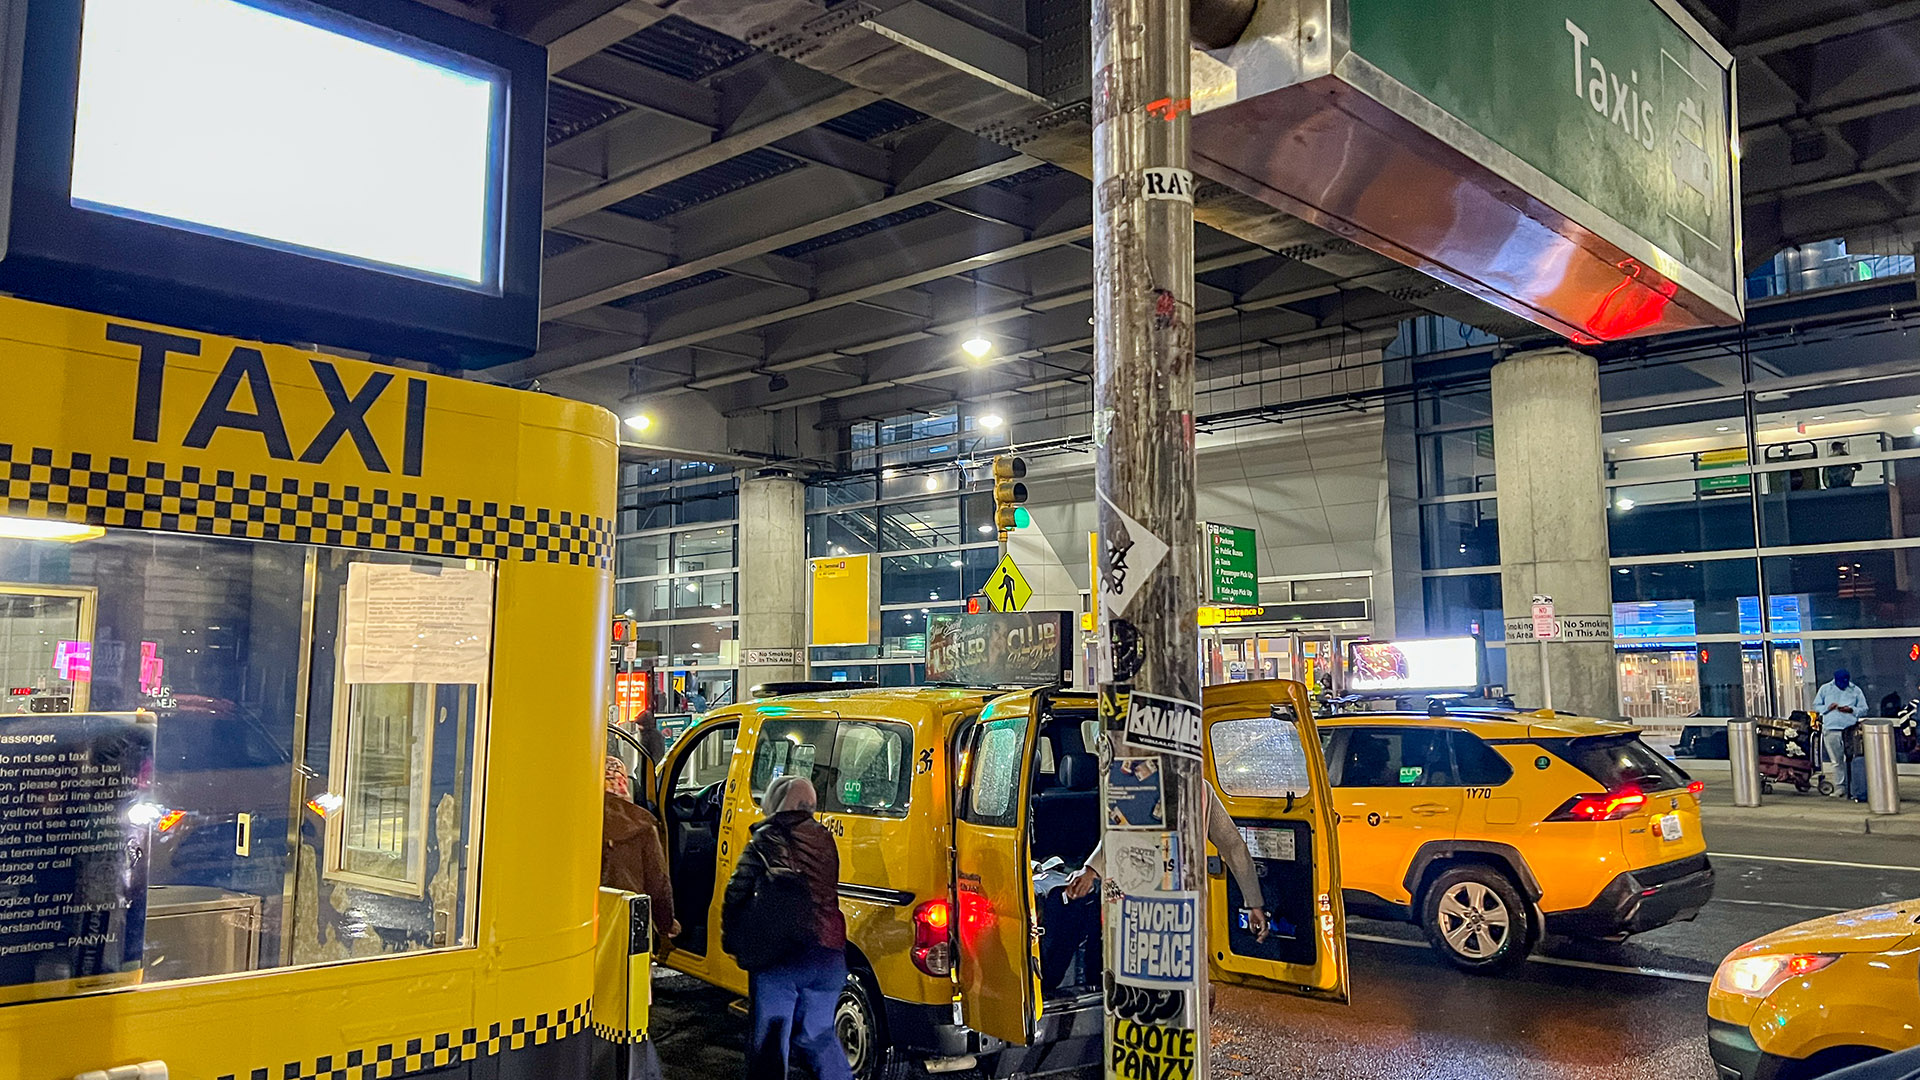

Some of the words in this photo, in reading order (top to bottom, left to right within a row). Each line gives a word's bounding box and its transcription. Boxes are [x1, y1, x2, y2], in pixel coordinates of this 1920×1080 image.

[1566, 18, 1655, 151] Taxis
[106, 322, 428, 477] TAXI
[1220, 536, 1235, 547] Parking
[1220, 547, 1232, 556] Public
[1221, 558, 1231, 566] Taxis
[1221, 569, 1240, 578] Passenger
[1230, 587, 1239, 597] App
[1225, 608, 1257, 616] Entrance
[1564, 620, 1577, 629] No
[1580, 620, 1609, 630] Smoking
[1007, 622, 1057, 655] CLUB
[1564, 630, 1573, 638] In
[1575, 629, 1593, 637] This
[1596, 629, 1609, 637] Area
[0, 735, 56, 745] assenger,
[13, 754, 31, 763] not
[34, 754, 55, 762] see
[69, 751, 89, 761] taxi
[22, 766, 78, 777] managing
[82, 764, 98, 774] the
[102, 764, 121, 772] taxi
[19, 780, 58, 792] please
[60, 777, 105, 790] proceed
[108, 776, 119, 786] to
[121, 775, 138, 785] the
[12, 793, 24, 804] of
[27, 792, 45, 802] the
[48, 791, 68, 801] taxi
[71, 791, 90, 800] line
[94, 789, 114, 799] and
[1466, 788, 1491, 799] 1Y70
[3, 806, 39, 819] yellow
[42, 805, 62, 815] taxi
[0, 823, 21, 833] you
[24, 820, 43, 830] not
[46, 820, 67, 829] see
[69, 818, 90, 828] any
[25, 834, 43, 844] the
[11, 845, 57, 857] terminal
[37, 860, 48, 869] or
[52, 858, 72, 868] call
[34, 893, 49, 903] for
[52, 892, 73, 903] any
[38, 906, 59, 917] and
[62, 902, 92, 914] thank
[95, 901, 115, 912] you
[1138, 901, 1193, 932] WORLD
[68, 933, 118, 947] PANYNJ.
[1130, 902, 1138, 974] DECLARE
[1138, 931, 1192, 978] PEACE
[1114, 1018, 1195, 1058] LOOTE
[1112, 1045, 1195, 1080] PANZY
